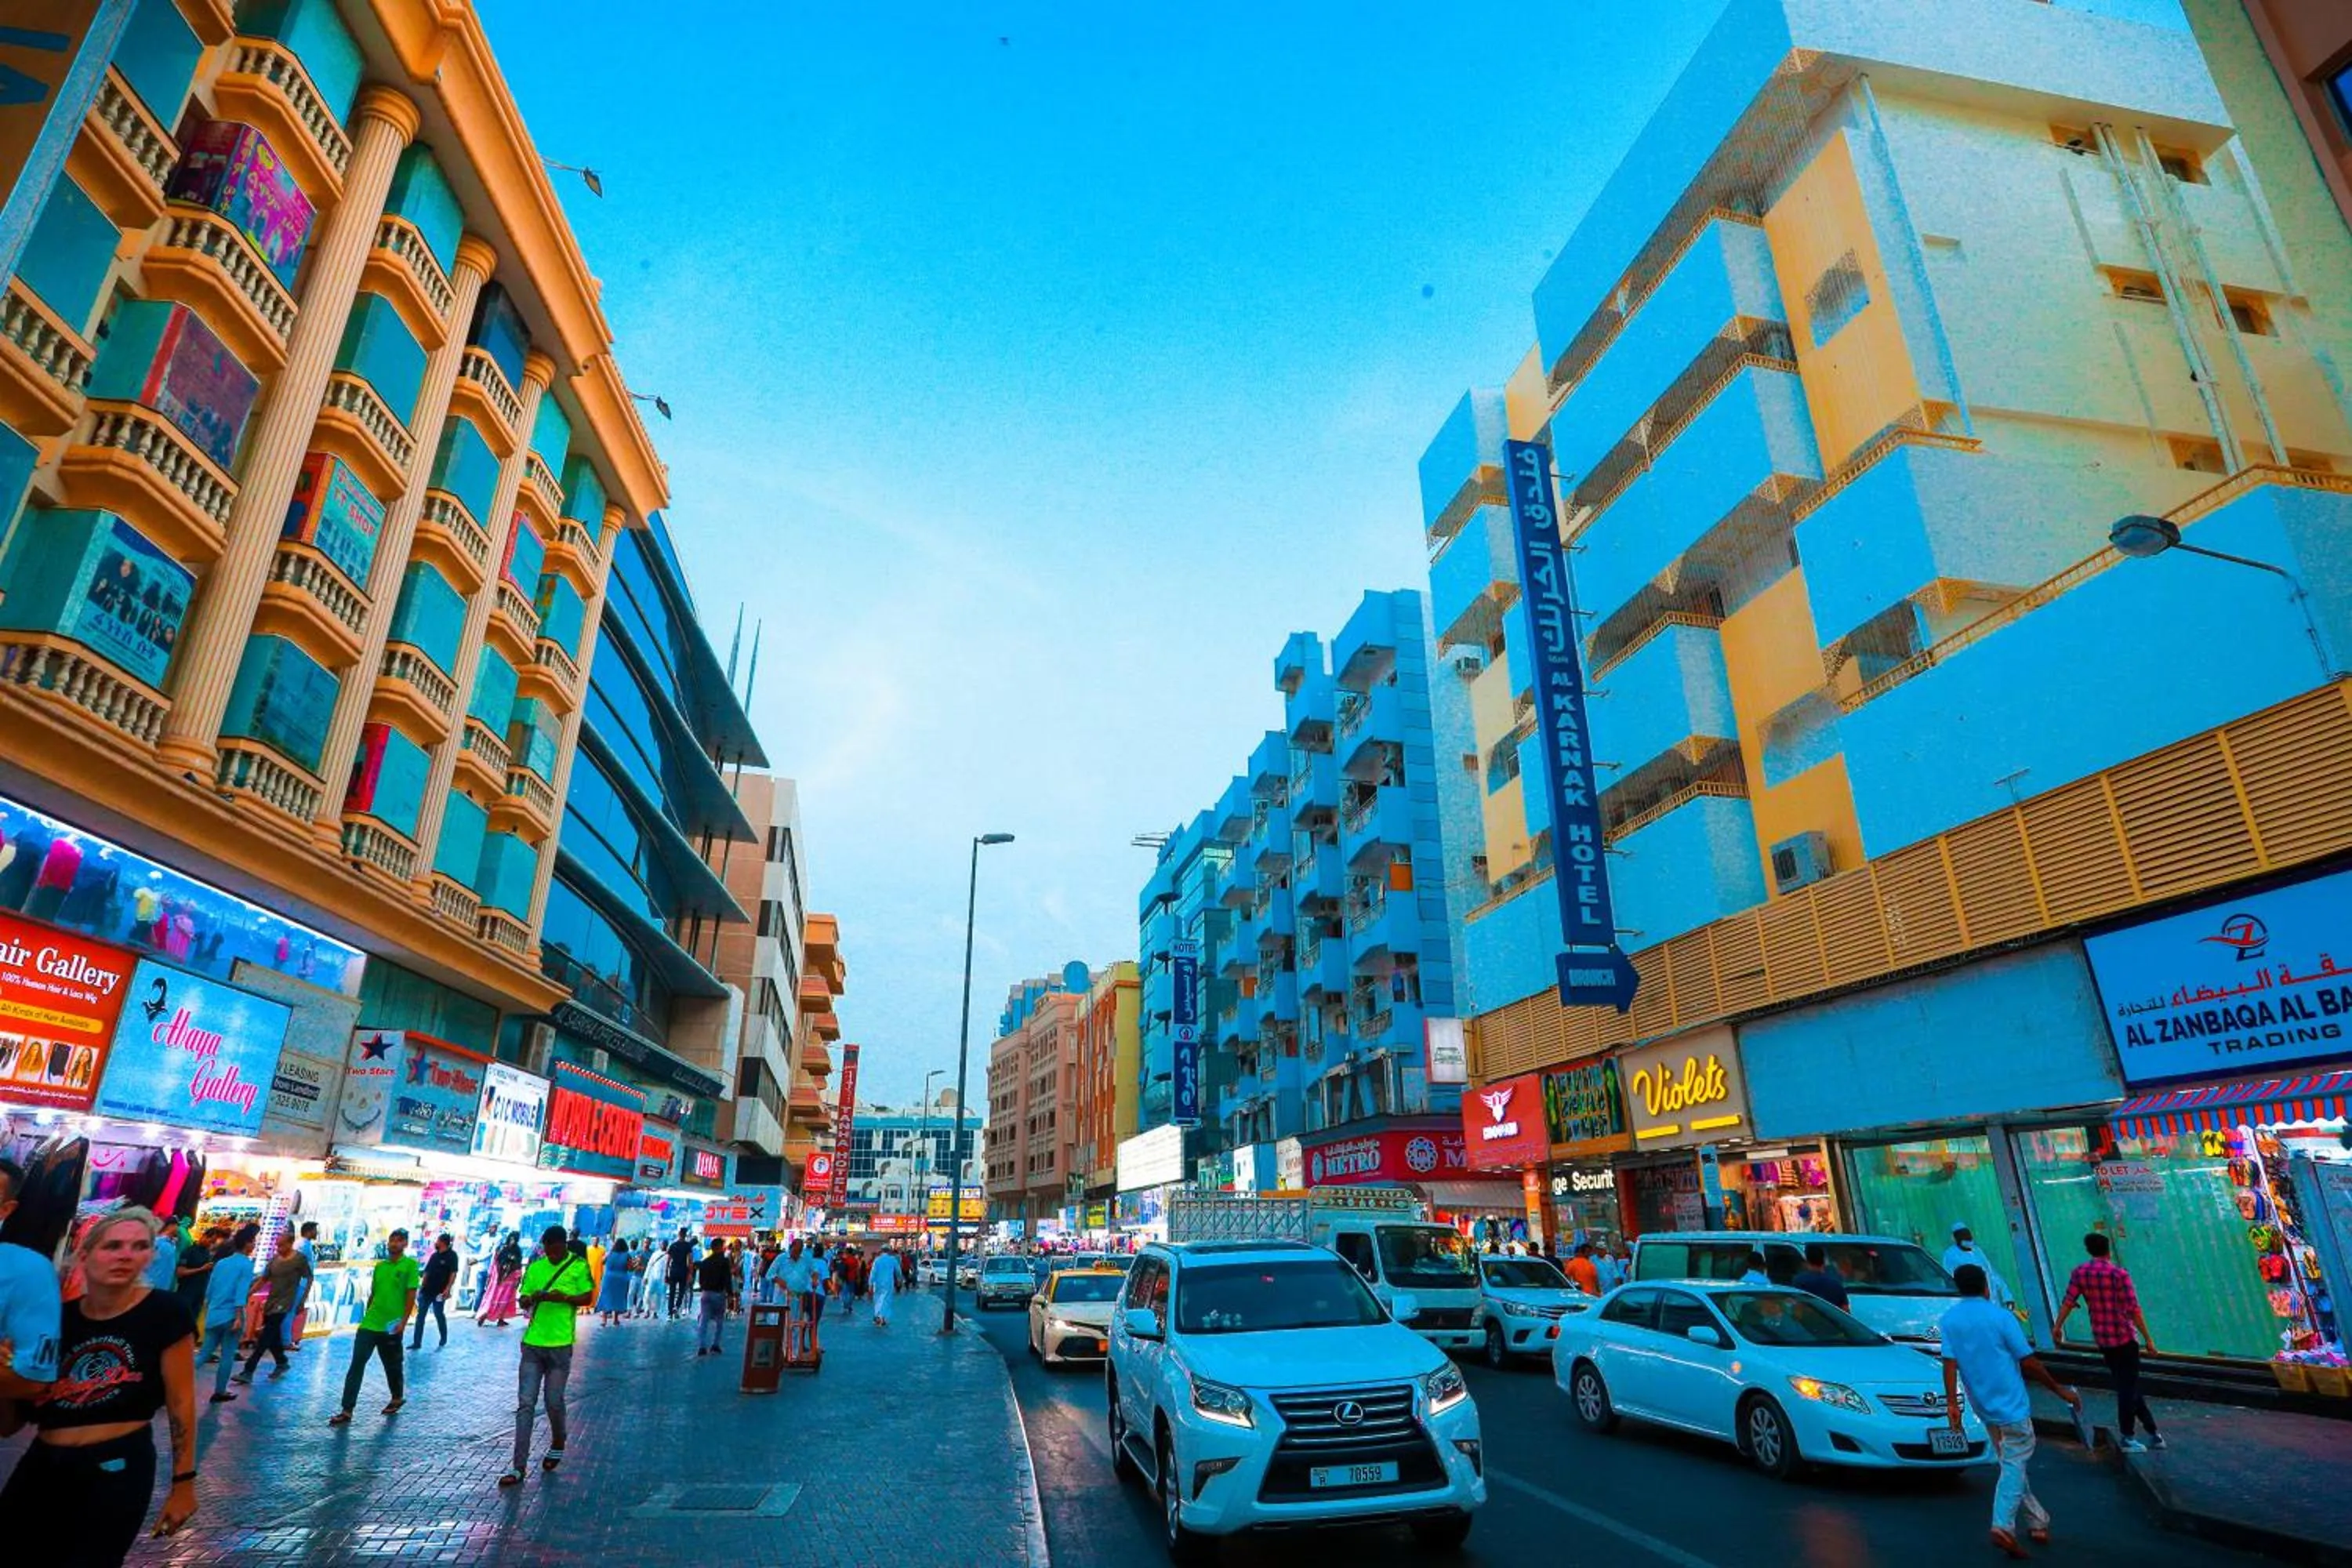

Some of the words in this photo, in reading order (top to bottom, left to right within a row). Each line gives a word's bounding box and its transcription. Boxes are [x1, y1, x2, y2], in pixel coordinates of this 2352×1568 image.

[1552, 672, 1573, 687] AL
[1553, 694, 1590, 807] KARNAK
[1569, 824, 1602, 925] HOTEL
[36, 946, 121, 996] Gallery
[2154, 1000, 2278, 1044] ZANBAQA
[2280, 993, 2317, 1023] AL
[2207, 1023, 2343, 1055] TRADING
[189, 1058, 258, 1116] Gallery
[285, 1063, 320, 1083] LEASING
[1633, 1054, 1728, 1116] Violets
